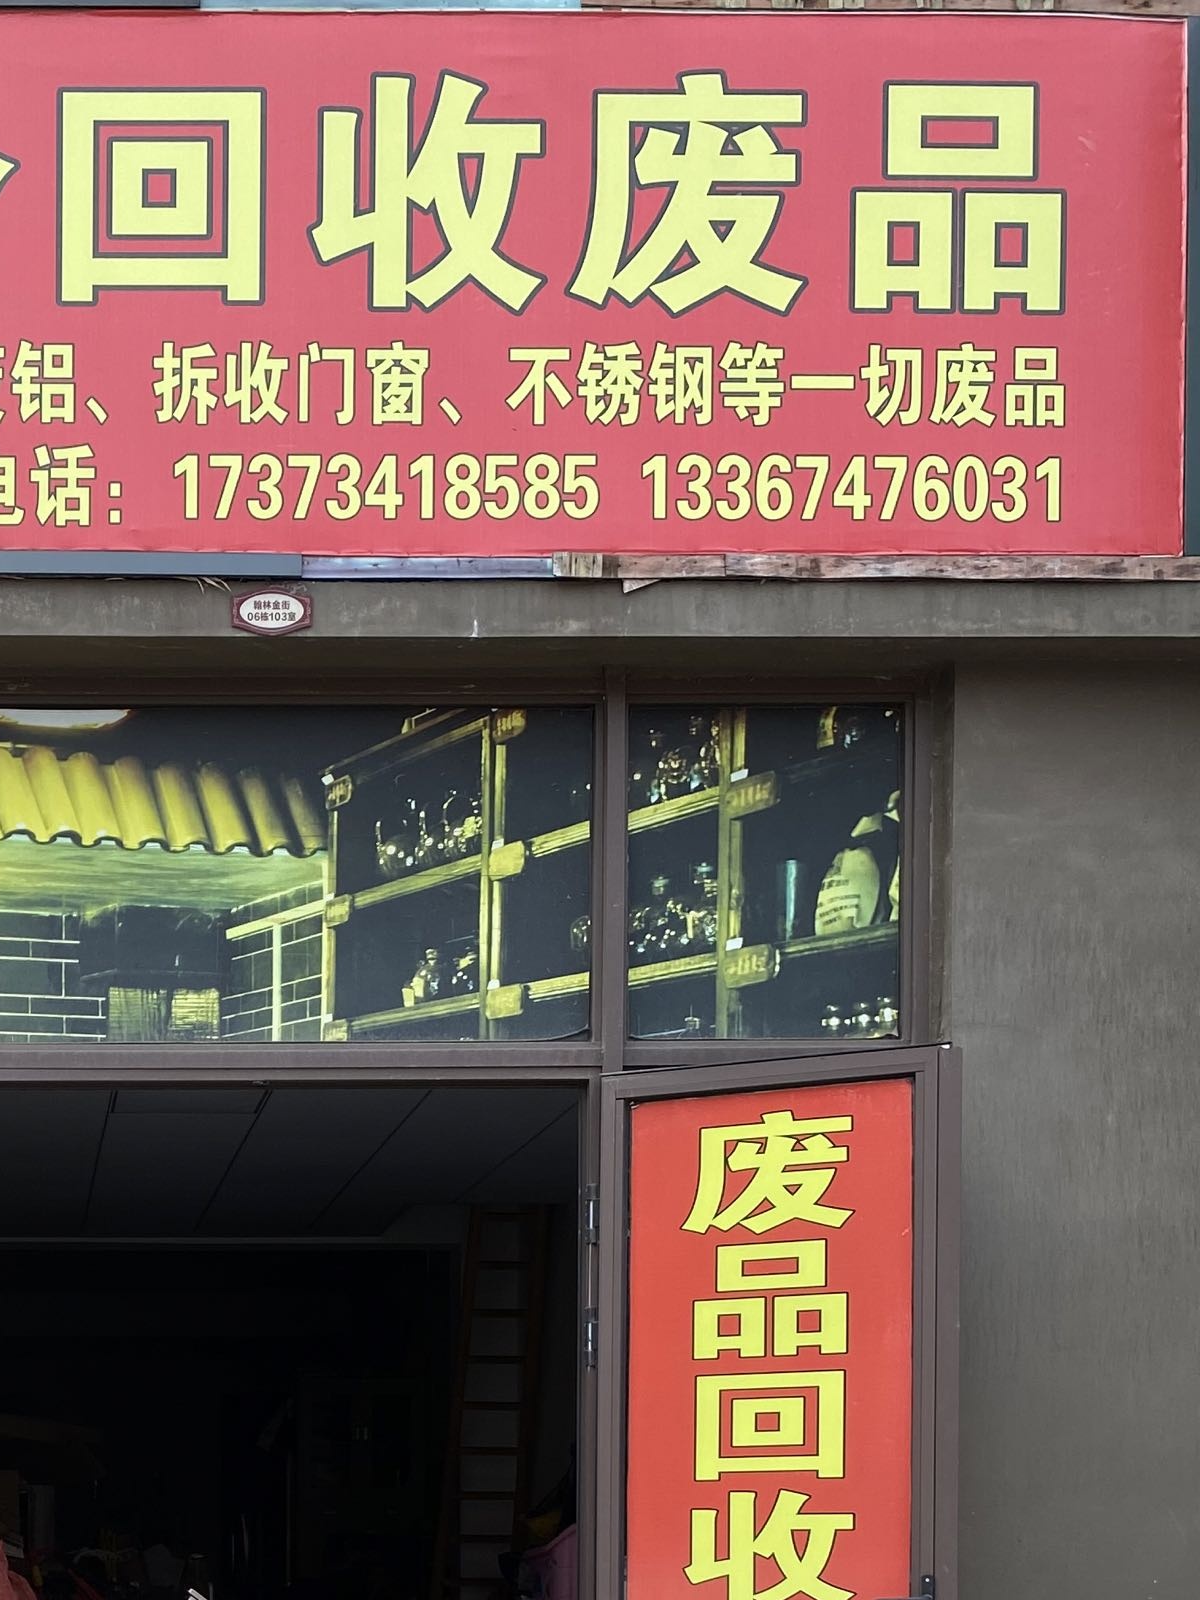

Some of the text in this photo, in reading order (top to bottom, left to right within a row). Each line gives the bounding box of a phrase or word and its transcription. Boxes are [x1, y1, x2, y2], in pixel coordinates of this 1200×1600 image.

[640, 454, 1062, 523] 13367476031
[253, 600, 290, 611] 翰林金街
[247, 611, 297, 622] 06栋103室
